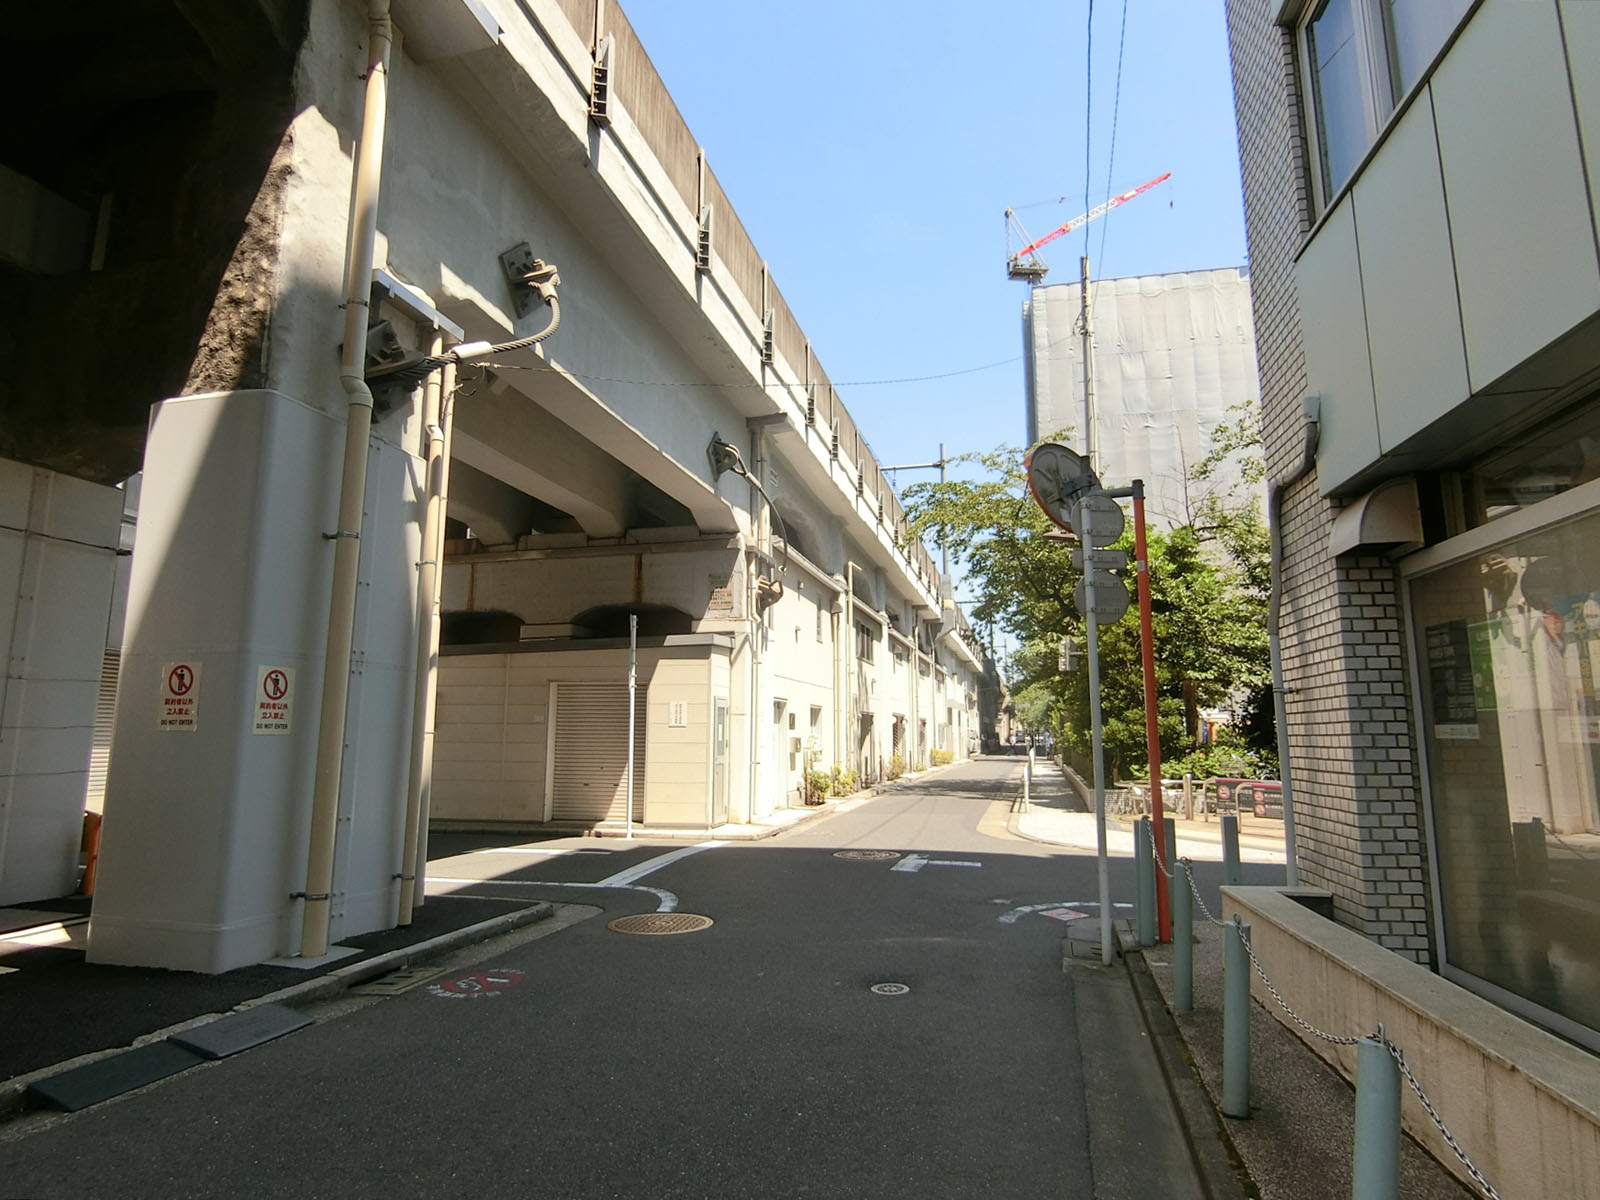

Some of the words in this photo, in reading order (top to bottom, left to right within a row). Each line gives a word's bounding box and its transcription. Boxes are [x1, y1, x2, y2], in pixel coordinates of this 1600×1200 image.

[166, 708, 190, 716] 立入禁止
[261, 711, 285, 720] 立入禁止
